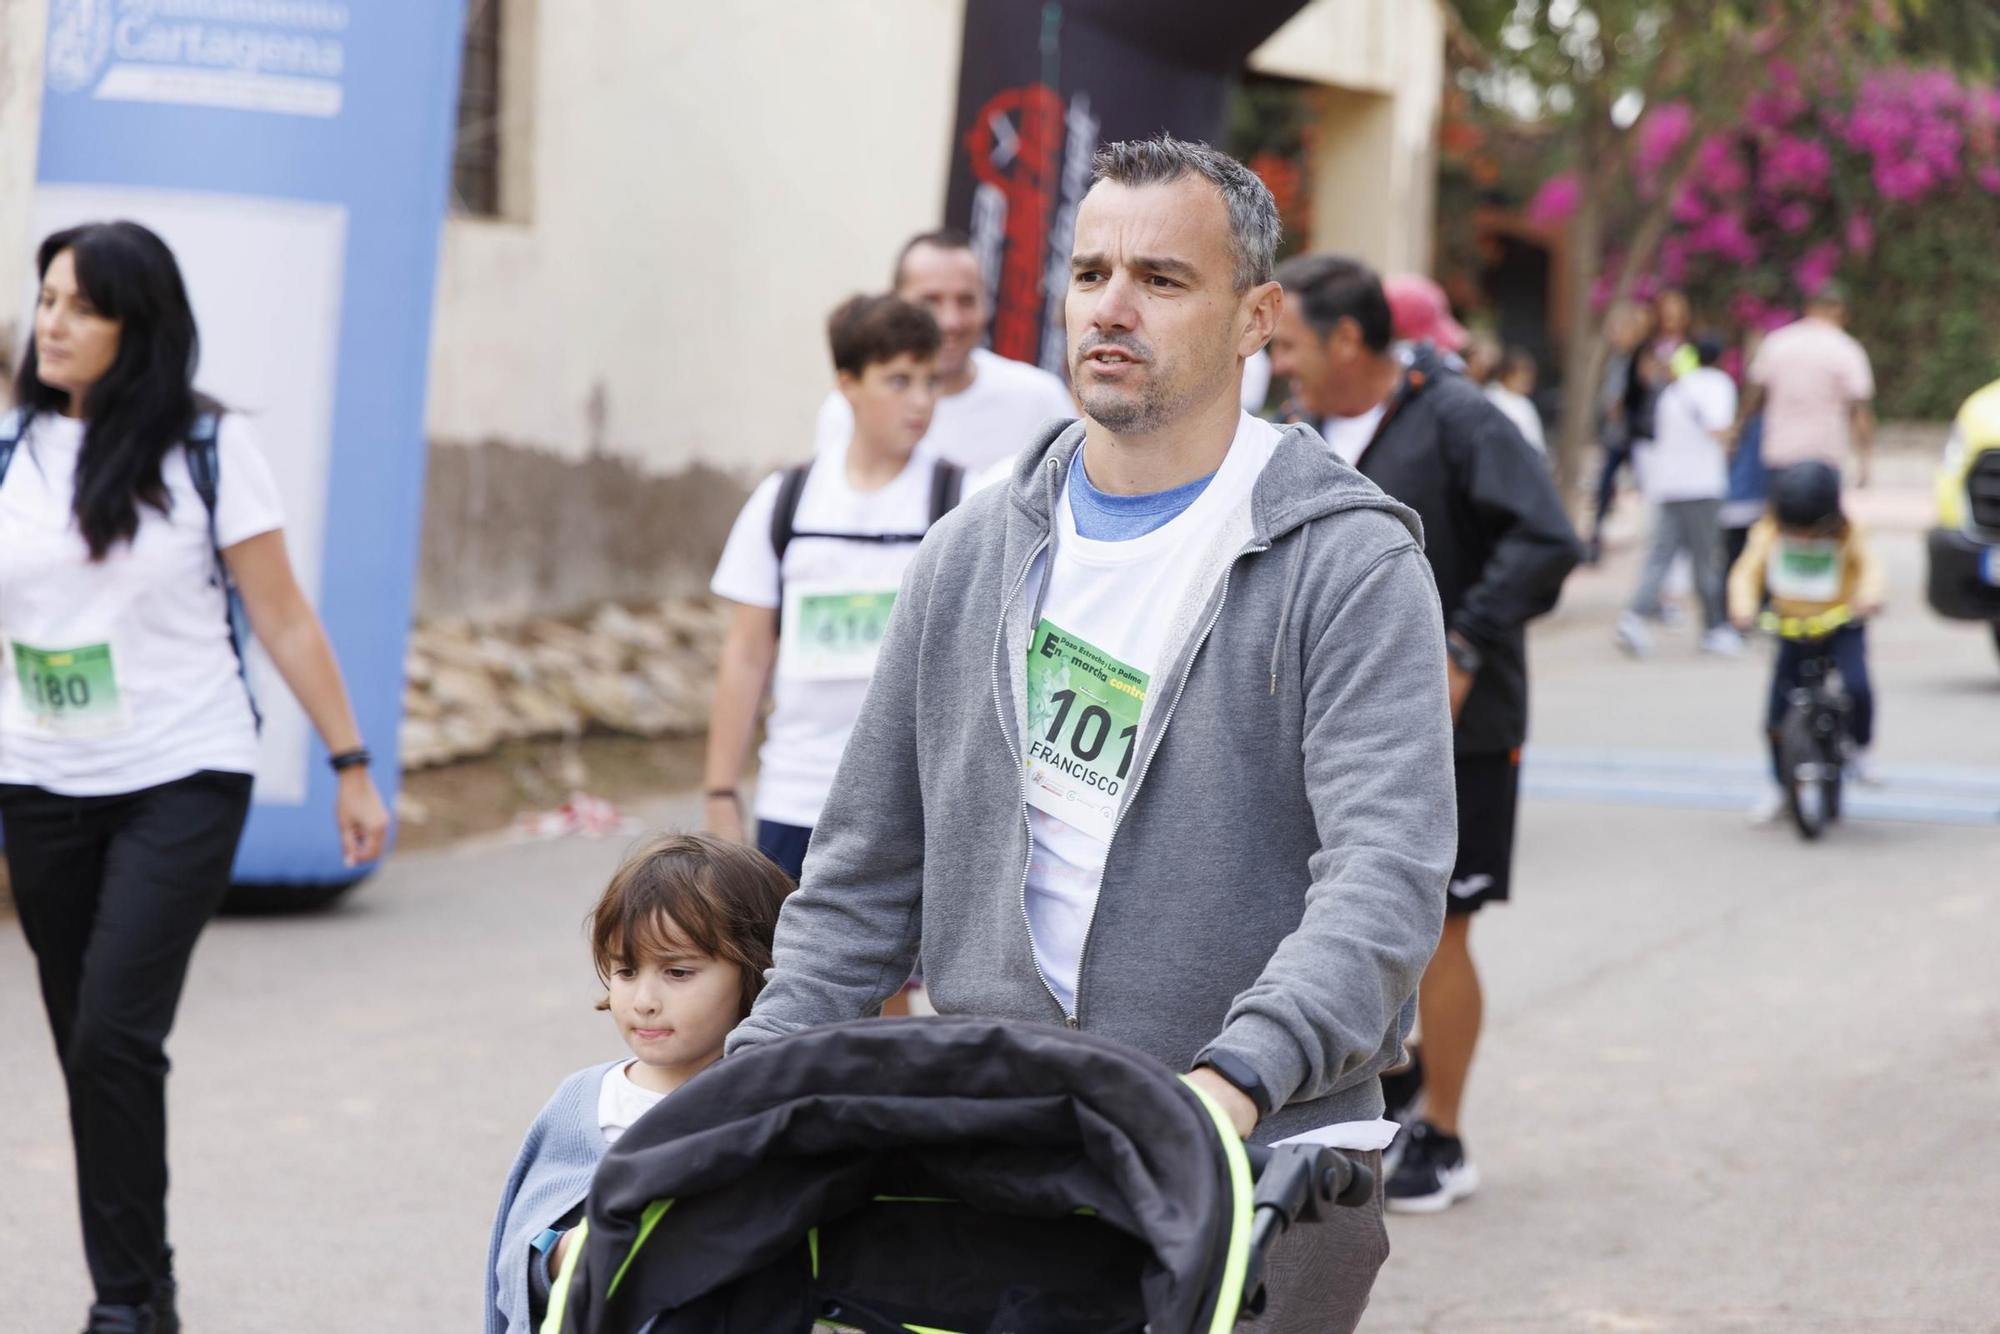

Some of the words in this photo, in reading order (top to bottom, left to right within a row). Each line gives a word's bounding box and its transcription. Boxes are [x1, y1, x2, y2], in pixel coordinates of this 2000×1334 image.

[115, 16, 344, 76] Cartagena
[1040, 632, 1062, 659] En
[1071, 656, 1108, 683] marcha
[1060, 637, 1078, 650] Pozo
[1108, 664, 1116, 673] La
[1117, 669, 1142, 685] Palma
[1045, 689, 1138, 781] 101
[1030, 741, 1119, 797] FRANCISCO
